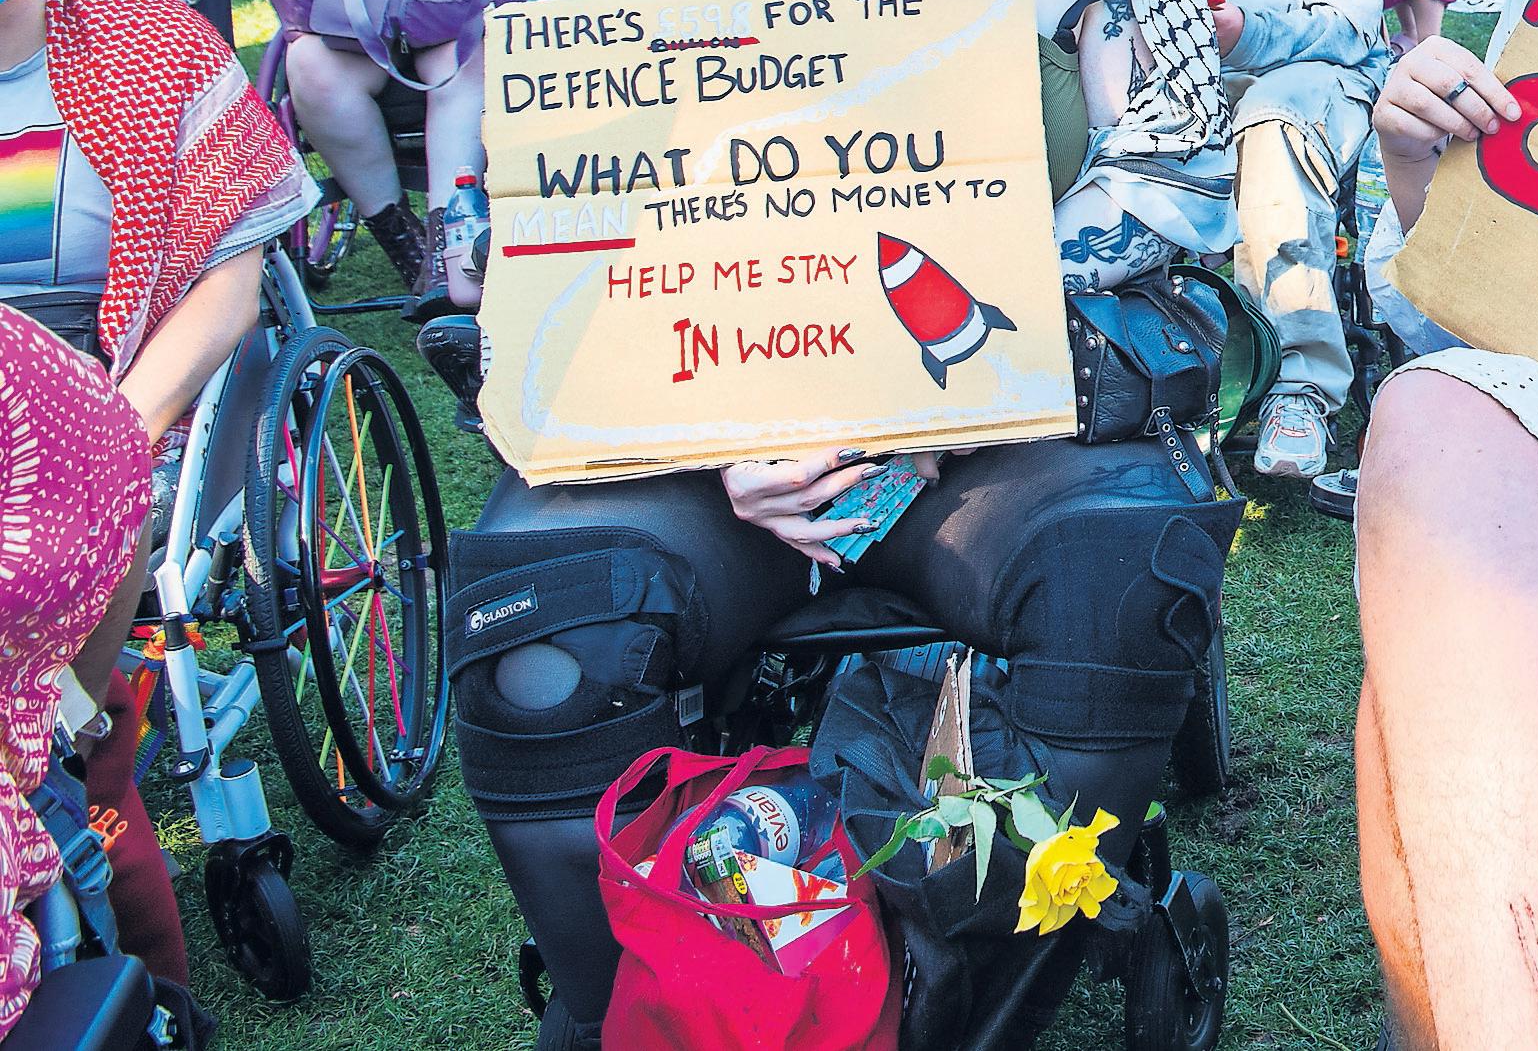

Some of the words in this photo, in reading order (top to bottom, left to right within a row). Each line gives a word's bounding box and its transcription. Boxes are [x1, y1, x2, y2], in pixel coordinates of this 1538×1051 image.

[493, 8, 642, 54] THERE'S
[503, 56, 677, 114] DEFENCE
[537, 148, 690, 198] WHAT
[731, 135, 799, 183] DO
[825, 130, 944, 180] YOU
[511, 200, 629, 246] MEAN
[766, 190, 815, 219] NO
[833, 177, 954, 211] MONEY
[966, 177, 1007, 200] TO
[607, 262, 694, 299] HELP
[715, 257, 761, 292] ME
[777, 254, 858, 287] STAY
[673, 317, 719, 383] IN
[737, 322, 854, 364] WORK
[483, 597, 532, 623] GLADTON
[746, 791, 789, 852] evian
